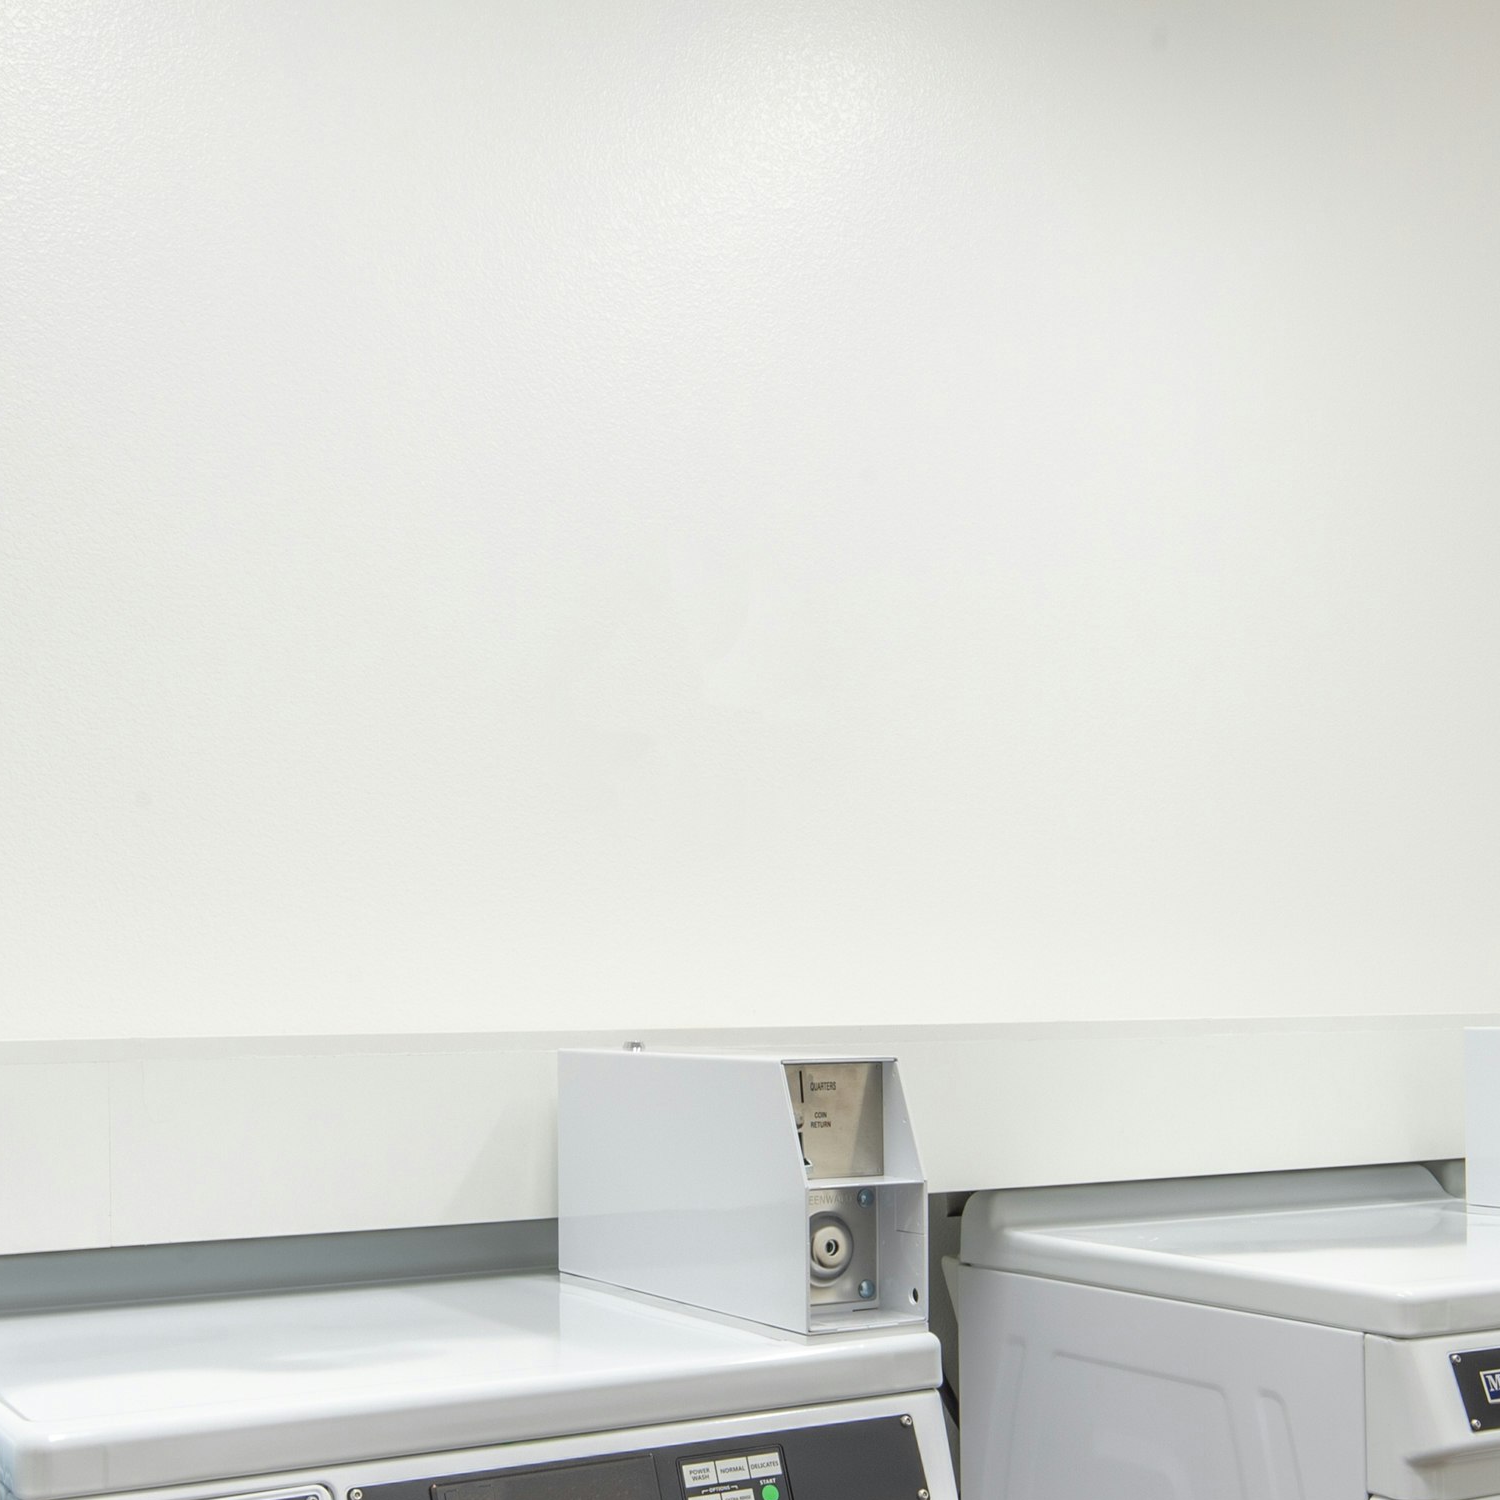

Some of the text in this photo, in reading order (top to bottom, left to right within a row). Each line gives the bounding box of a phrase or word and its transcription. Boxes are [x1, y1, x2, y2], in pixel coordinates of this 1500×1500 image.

[810, 1081, 836, 1091] QUARTERS
[750, 1460, 779, 1470] DELICATES
[689, 1467, 710, 1476] POWER
[720, 1465, 746, 1475] NORMAL
[692, 1474, 710, 1482] WASH
[759, 1477, 777, 1486] START
